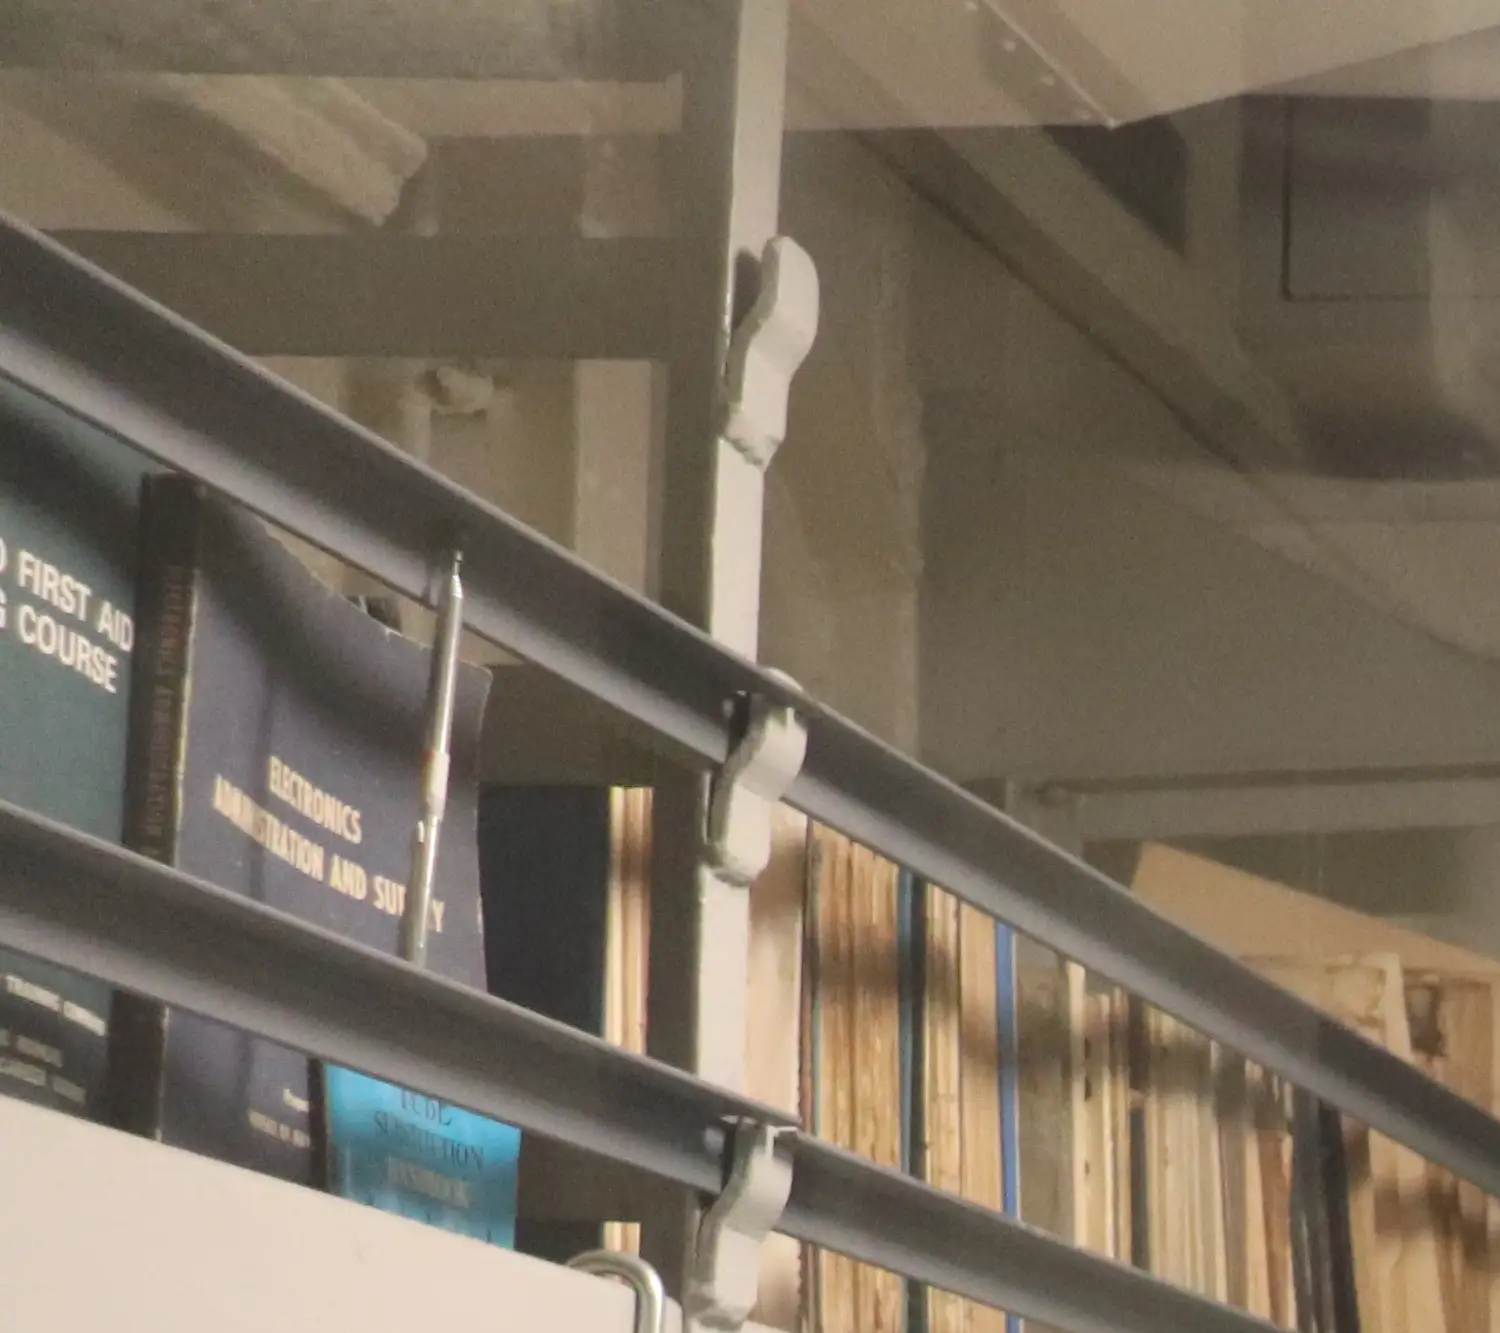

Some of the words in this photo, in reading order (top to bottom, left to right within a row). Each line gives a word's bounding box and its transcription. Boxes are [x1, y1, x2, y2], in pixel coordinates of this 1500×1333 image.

[18, 549, 93, 622] FIRST
[97, 599, 134, 653] AID
[18, 604, 118, 694] COURSE
[268, 754, 363, 845] ELECTRONICS
[329, 852, 368, 901] AND
[372, 873, 446, 934] SUPY
